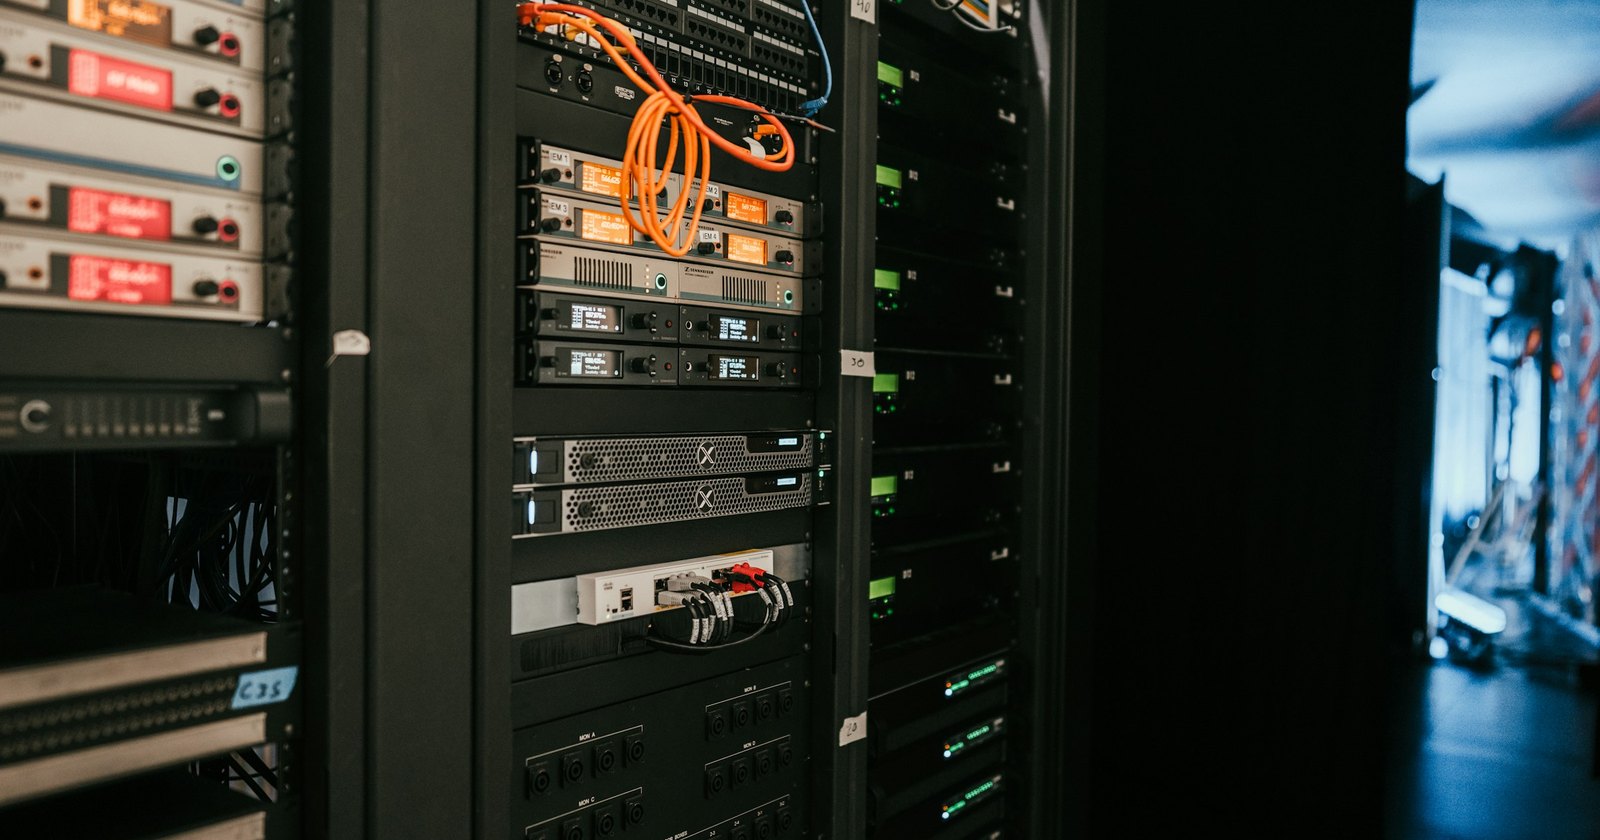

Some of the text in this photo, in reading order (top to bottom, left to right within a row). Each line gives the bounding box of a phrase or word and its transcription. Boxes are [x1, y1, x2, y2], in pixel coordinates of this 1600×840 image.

[714, 187, 718, 195] 2
[562, 204, 568, 213] 3
[851, 358, 865, 368] 30
[579, 733, 590, 741] MON
[578, 798, 590, 807] MON
